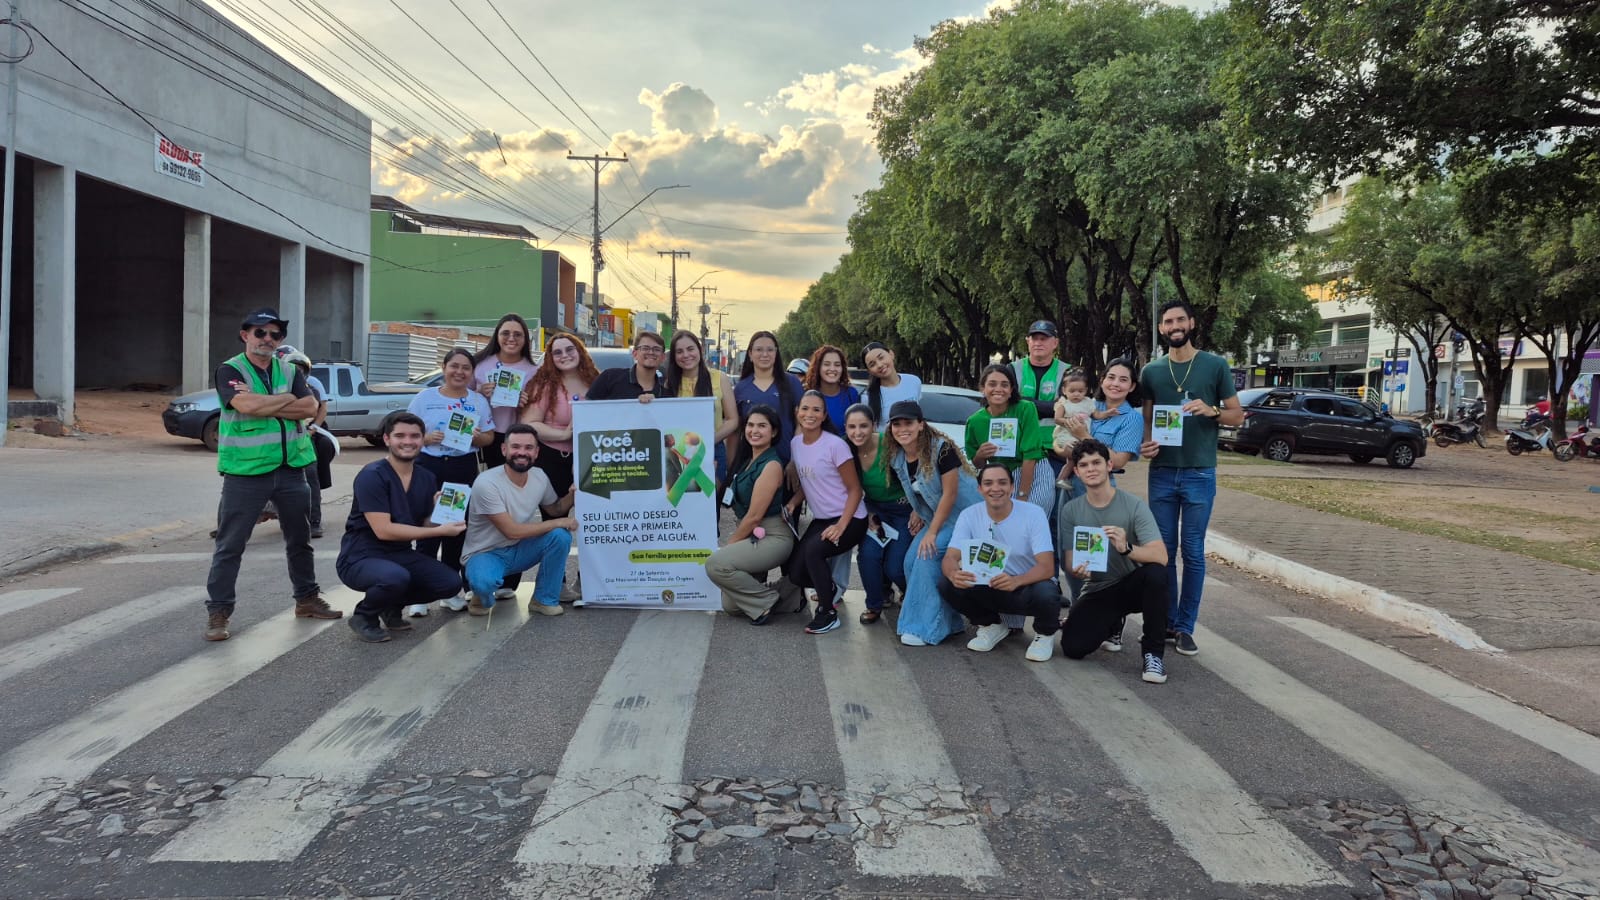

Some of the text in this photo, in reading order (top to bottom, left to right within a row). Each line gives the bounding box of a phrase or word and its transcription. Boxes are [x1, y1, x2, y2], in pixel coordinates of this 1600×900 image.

[591, 432, 633, 448] Você
[591, 448, 650, 463] decide!
[582, 510, 679, 522] SEU ÚLTIMO DESEJO
[583, 521, 683, 533] PODE SER A PRIMEIRA
[584, 535, 639, 545] ESPERANÇA
[642, 534, 655, 542] DE
[667, 552, 692, 560] precisa
